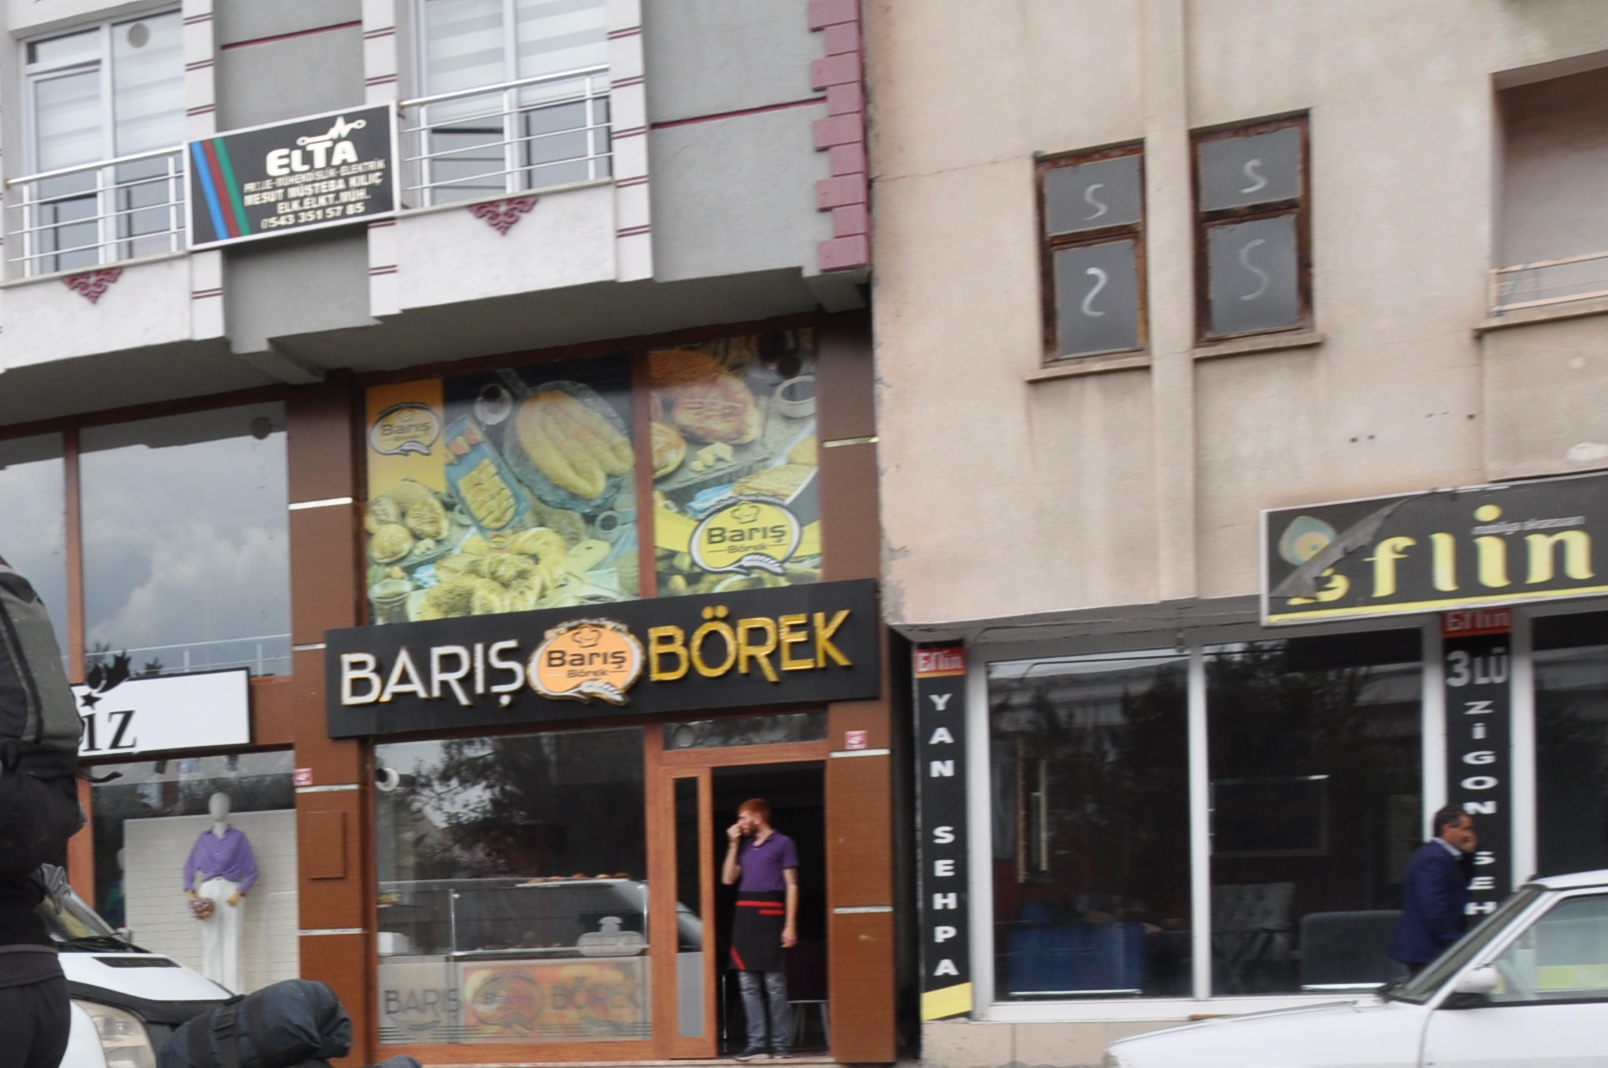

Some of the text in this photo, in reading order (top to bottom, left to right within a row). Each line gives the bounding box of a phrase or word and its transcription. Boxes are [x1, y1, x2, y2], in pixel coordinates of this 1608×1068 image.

[265, 140, 359, 176] ELTA
[297, 207, 324, 222] 351
[327, 205, 344, 218] 57
[339, 605, 853, 707] BARIŞ BÖREK
[545, 648, 628, 673] Barış
[918, 651, 963, 673] Eflin
[928, 693, 960, 976] YAN SEHPA
